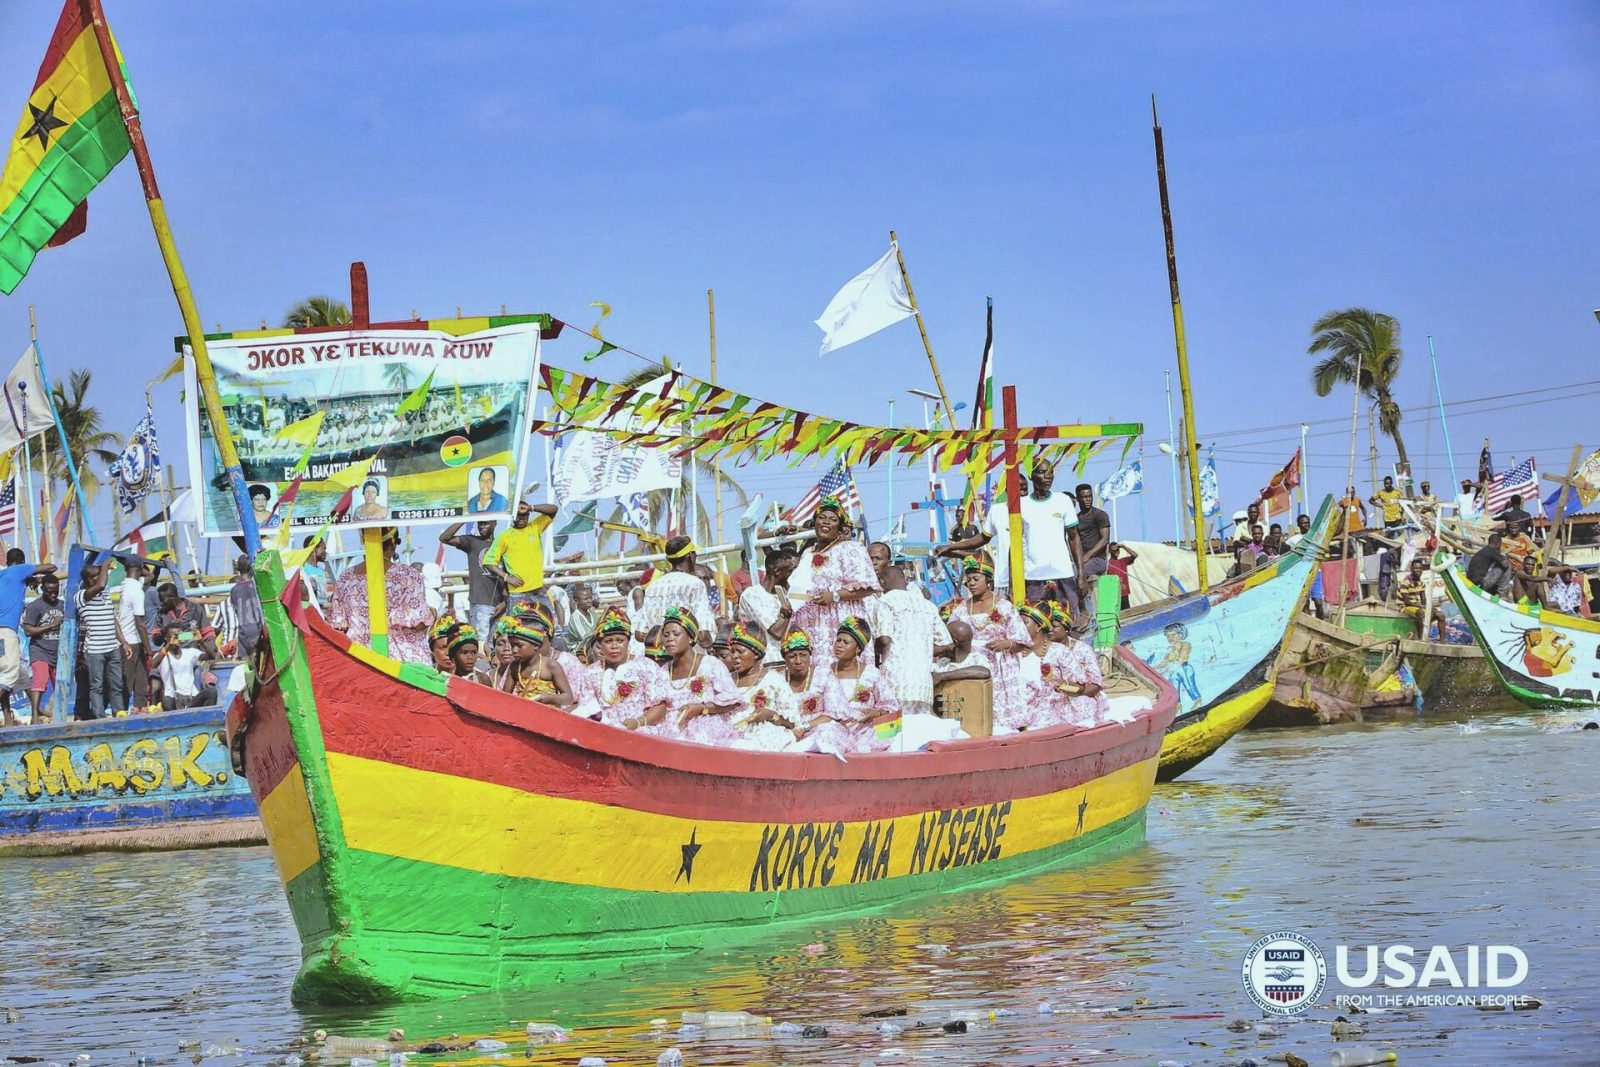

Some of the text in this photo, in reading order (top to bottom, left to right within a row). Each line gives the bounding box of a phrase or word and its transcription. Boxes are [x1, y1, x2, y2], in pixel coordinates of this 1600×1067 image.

[345, 341, 435, 358] TEKUWA
[443, 341, 494, 359] KUW
[850, 818, 895, 884] MA
[909, 800, 1012, 875] NTSEASE
